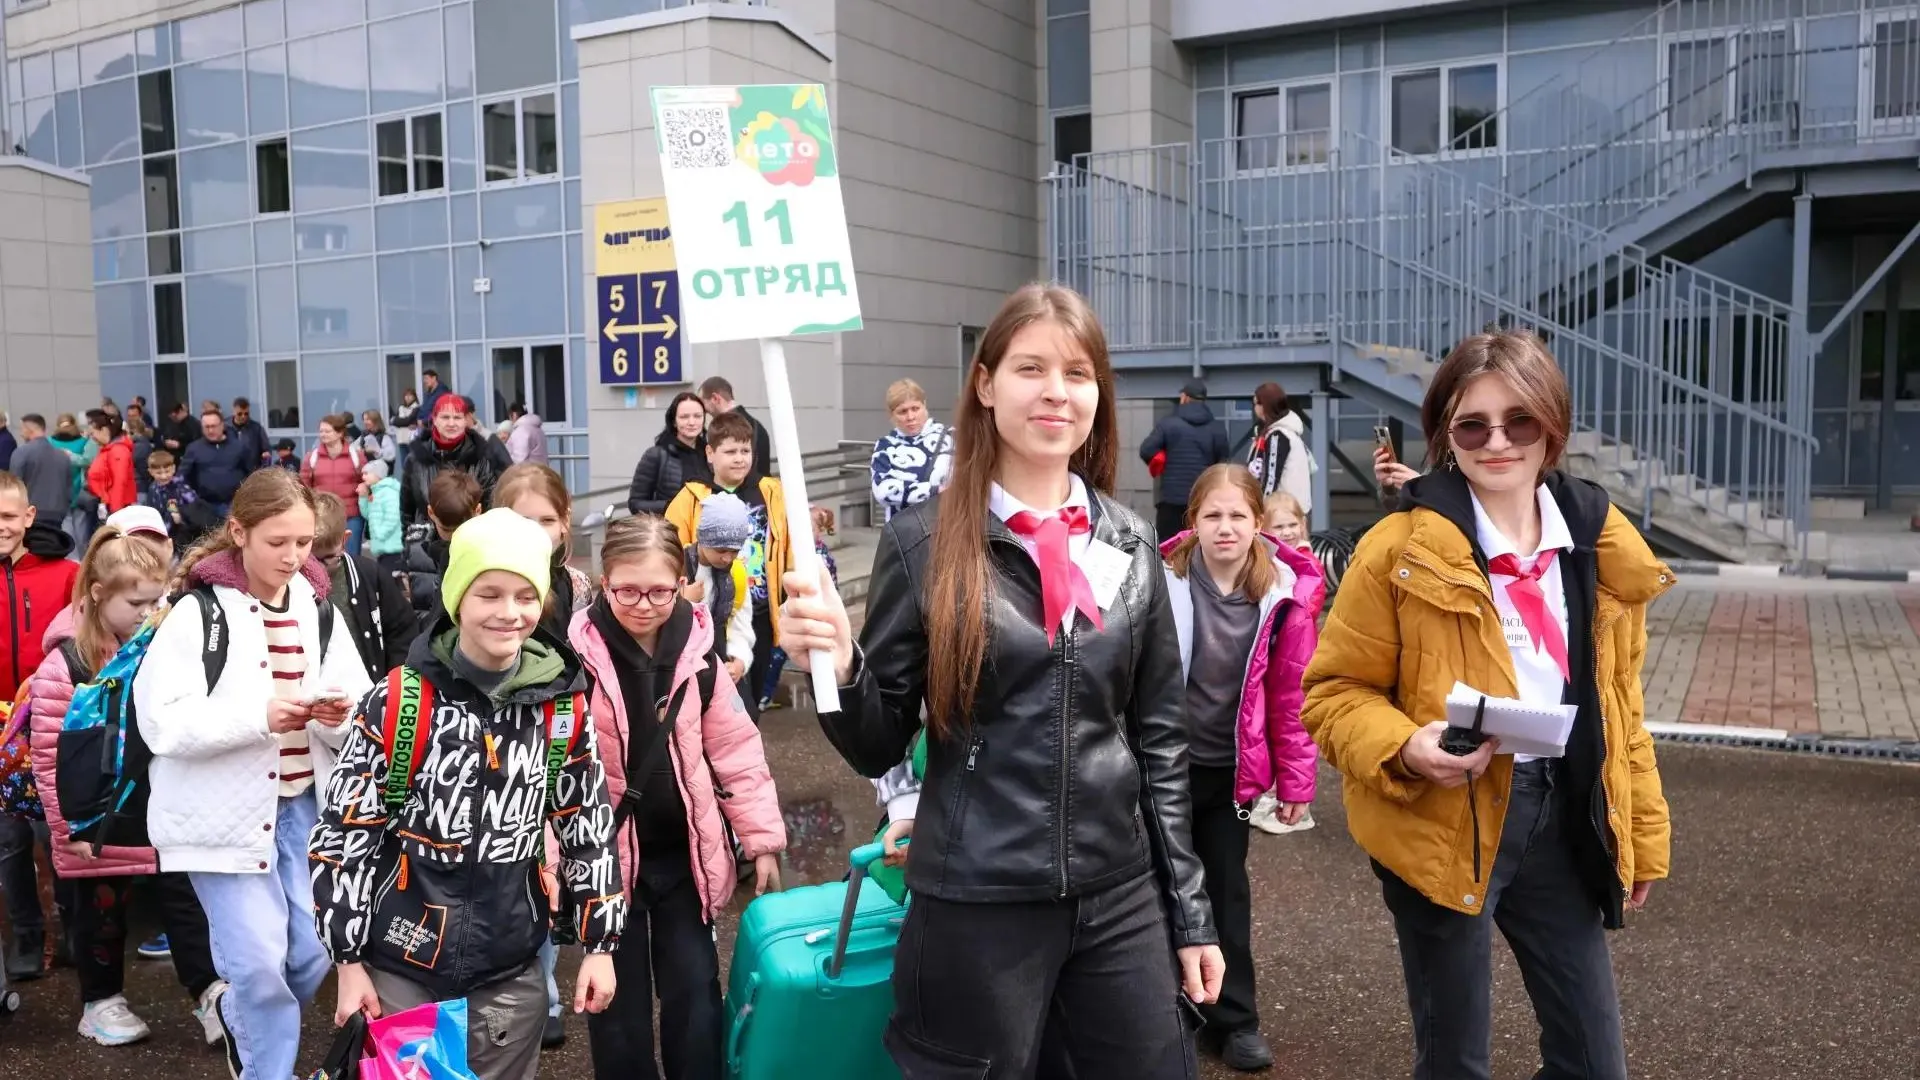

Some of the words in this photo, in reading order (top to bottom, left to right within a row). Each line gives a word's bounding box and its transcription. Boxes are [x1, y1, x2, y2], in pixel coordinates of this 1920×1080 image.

[722, 199, 796, 247] 11
[692, 261, 849, 300] ОТРЯД
[609, 284, 625, 313] 5
[652, 281, 668, 309] 7
[612, 348, 628, 376] 6
[653, 346, 670, 374] 8
[208, 623, 220, 652] arena
[403, 687, 420, 700] И
[551, 744, 567, 756] И
